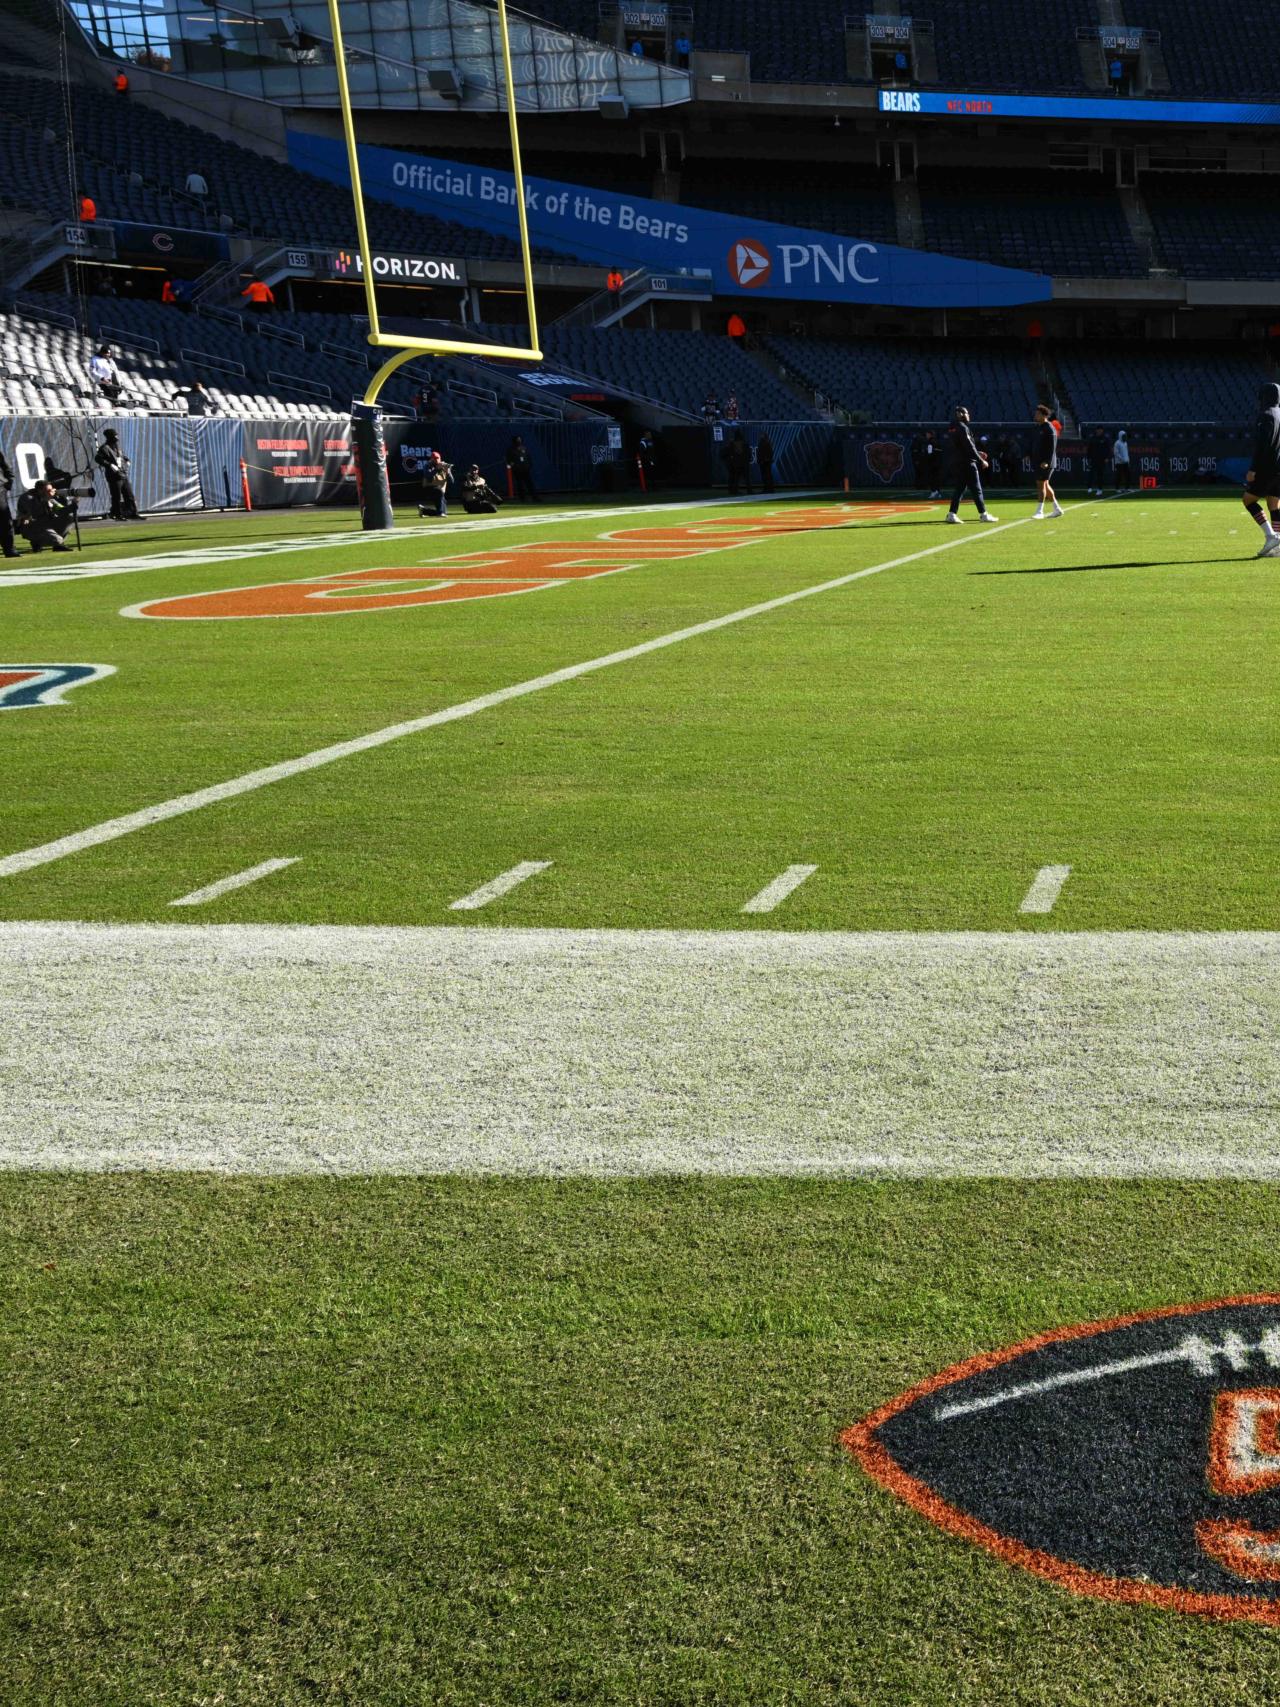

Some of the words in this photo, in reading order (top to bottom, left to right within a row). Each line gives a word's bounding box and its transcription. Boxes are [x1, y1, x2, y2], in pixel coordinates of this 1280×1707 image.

[871, 26, 884, 37] 303
[895, 28, 908, 38] 304
[1127, 38, 1139, 48] 305
[882, 91, 920, 112] BEARS
[392, 162, 473, 197] Official
[545, 192, 568, 216] of
[574, 196, 612, 225] the
[618, 204, 688, 243] Bears
[66, 228, 86, 244] 154
[288, 253, 306, 266] 155
[776, 243, 879, 284] PNC
[652, 278, 667, 290] 101
[400, 444, 432, 457] Bears
[1140, 457, 1160, 473] 1946
[1170, 457, 1188, 473] 1963
[1198, 457, 1217, 473] 1985
